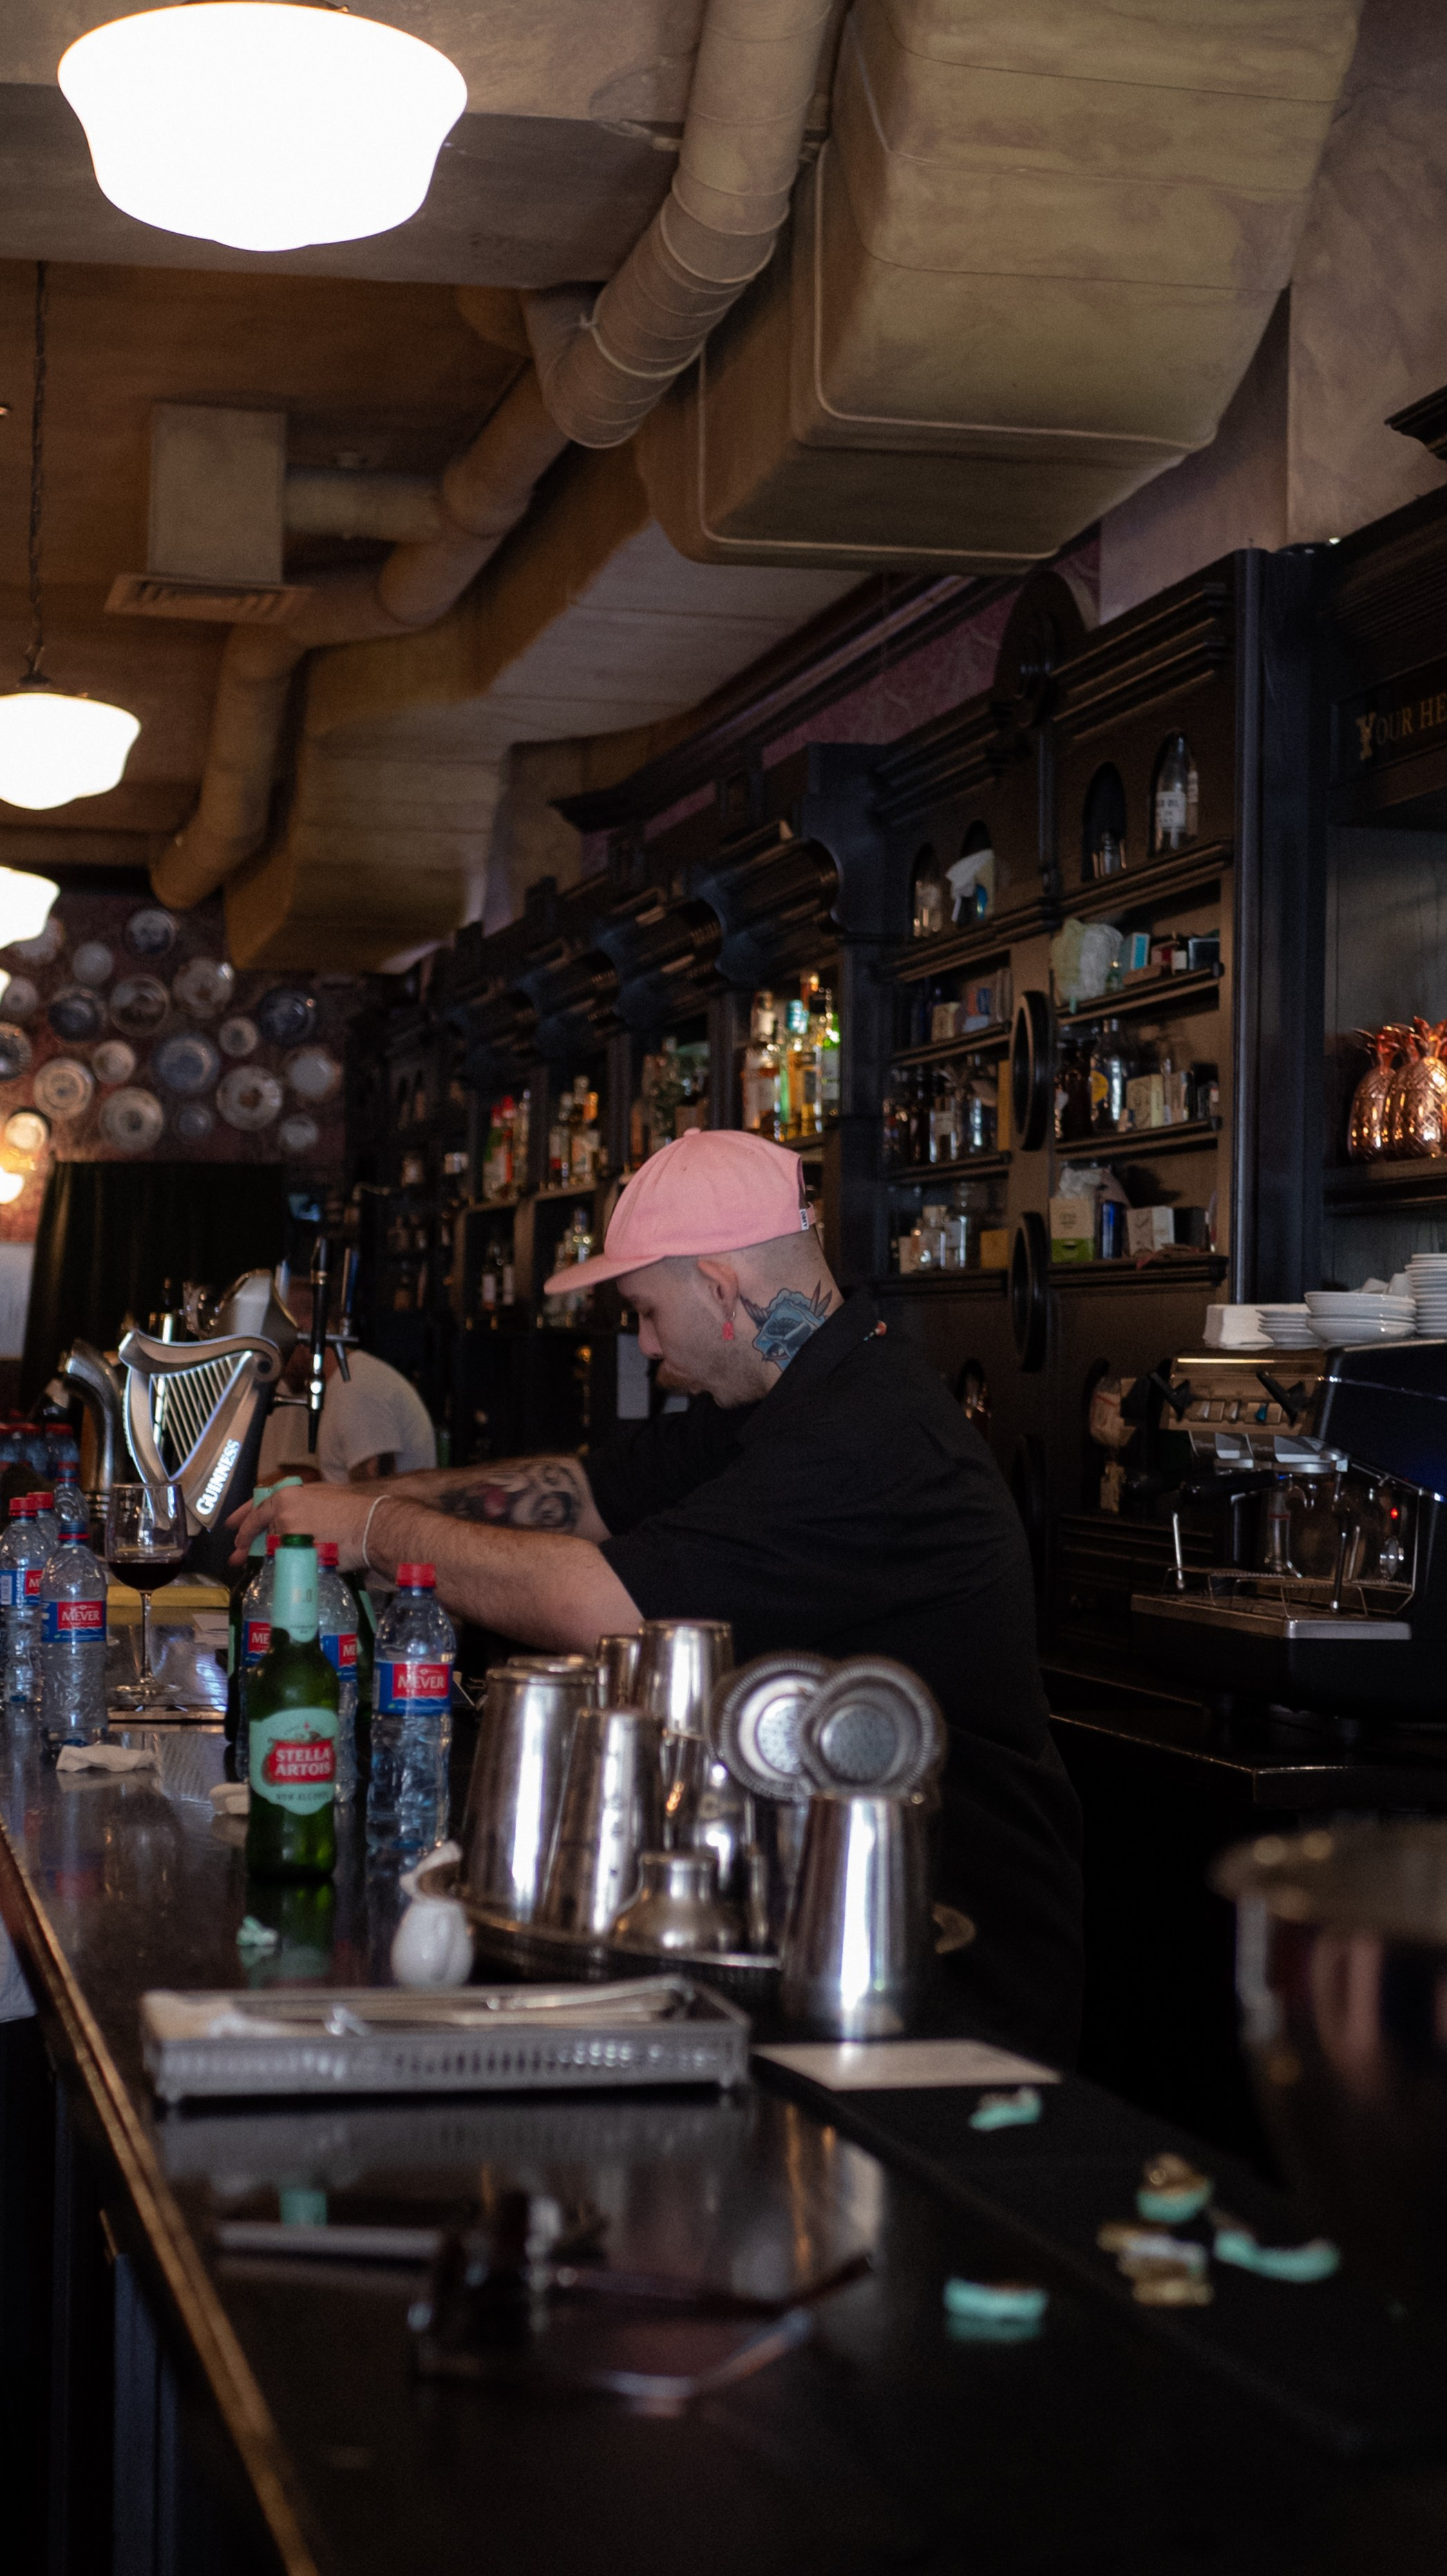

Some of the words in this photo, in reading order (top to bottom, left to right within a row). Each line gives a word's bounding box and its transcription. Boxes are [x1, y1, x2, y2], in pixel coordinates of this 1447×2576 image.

[1355, 706, 1414, 761] YOUR
[196, 1439, 240, 1515] GUINNESS
[62, 1609, 100, 1622] MEVER
[397, 1674, 445, 1689] MEVER
[276, 1746, 330, 1762] STELLA
[274, 1761, 332, 1777] ARTOIS
